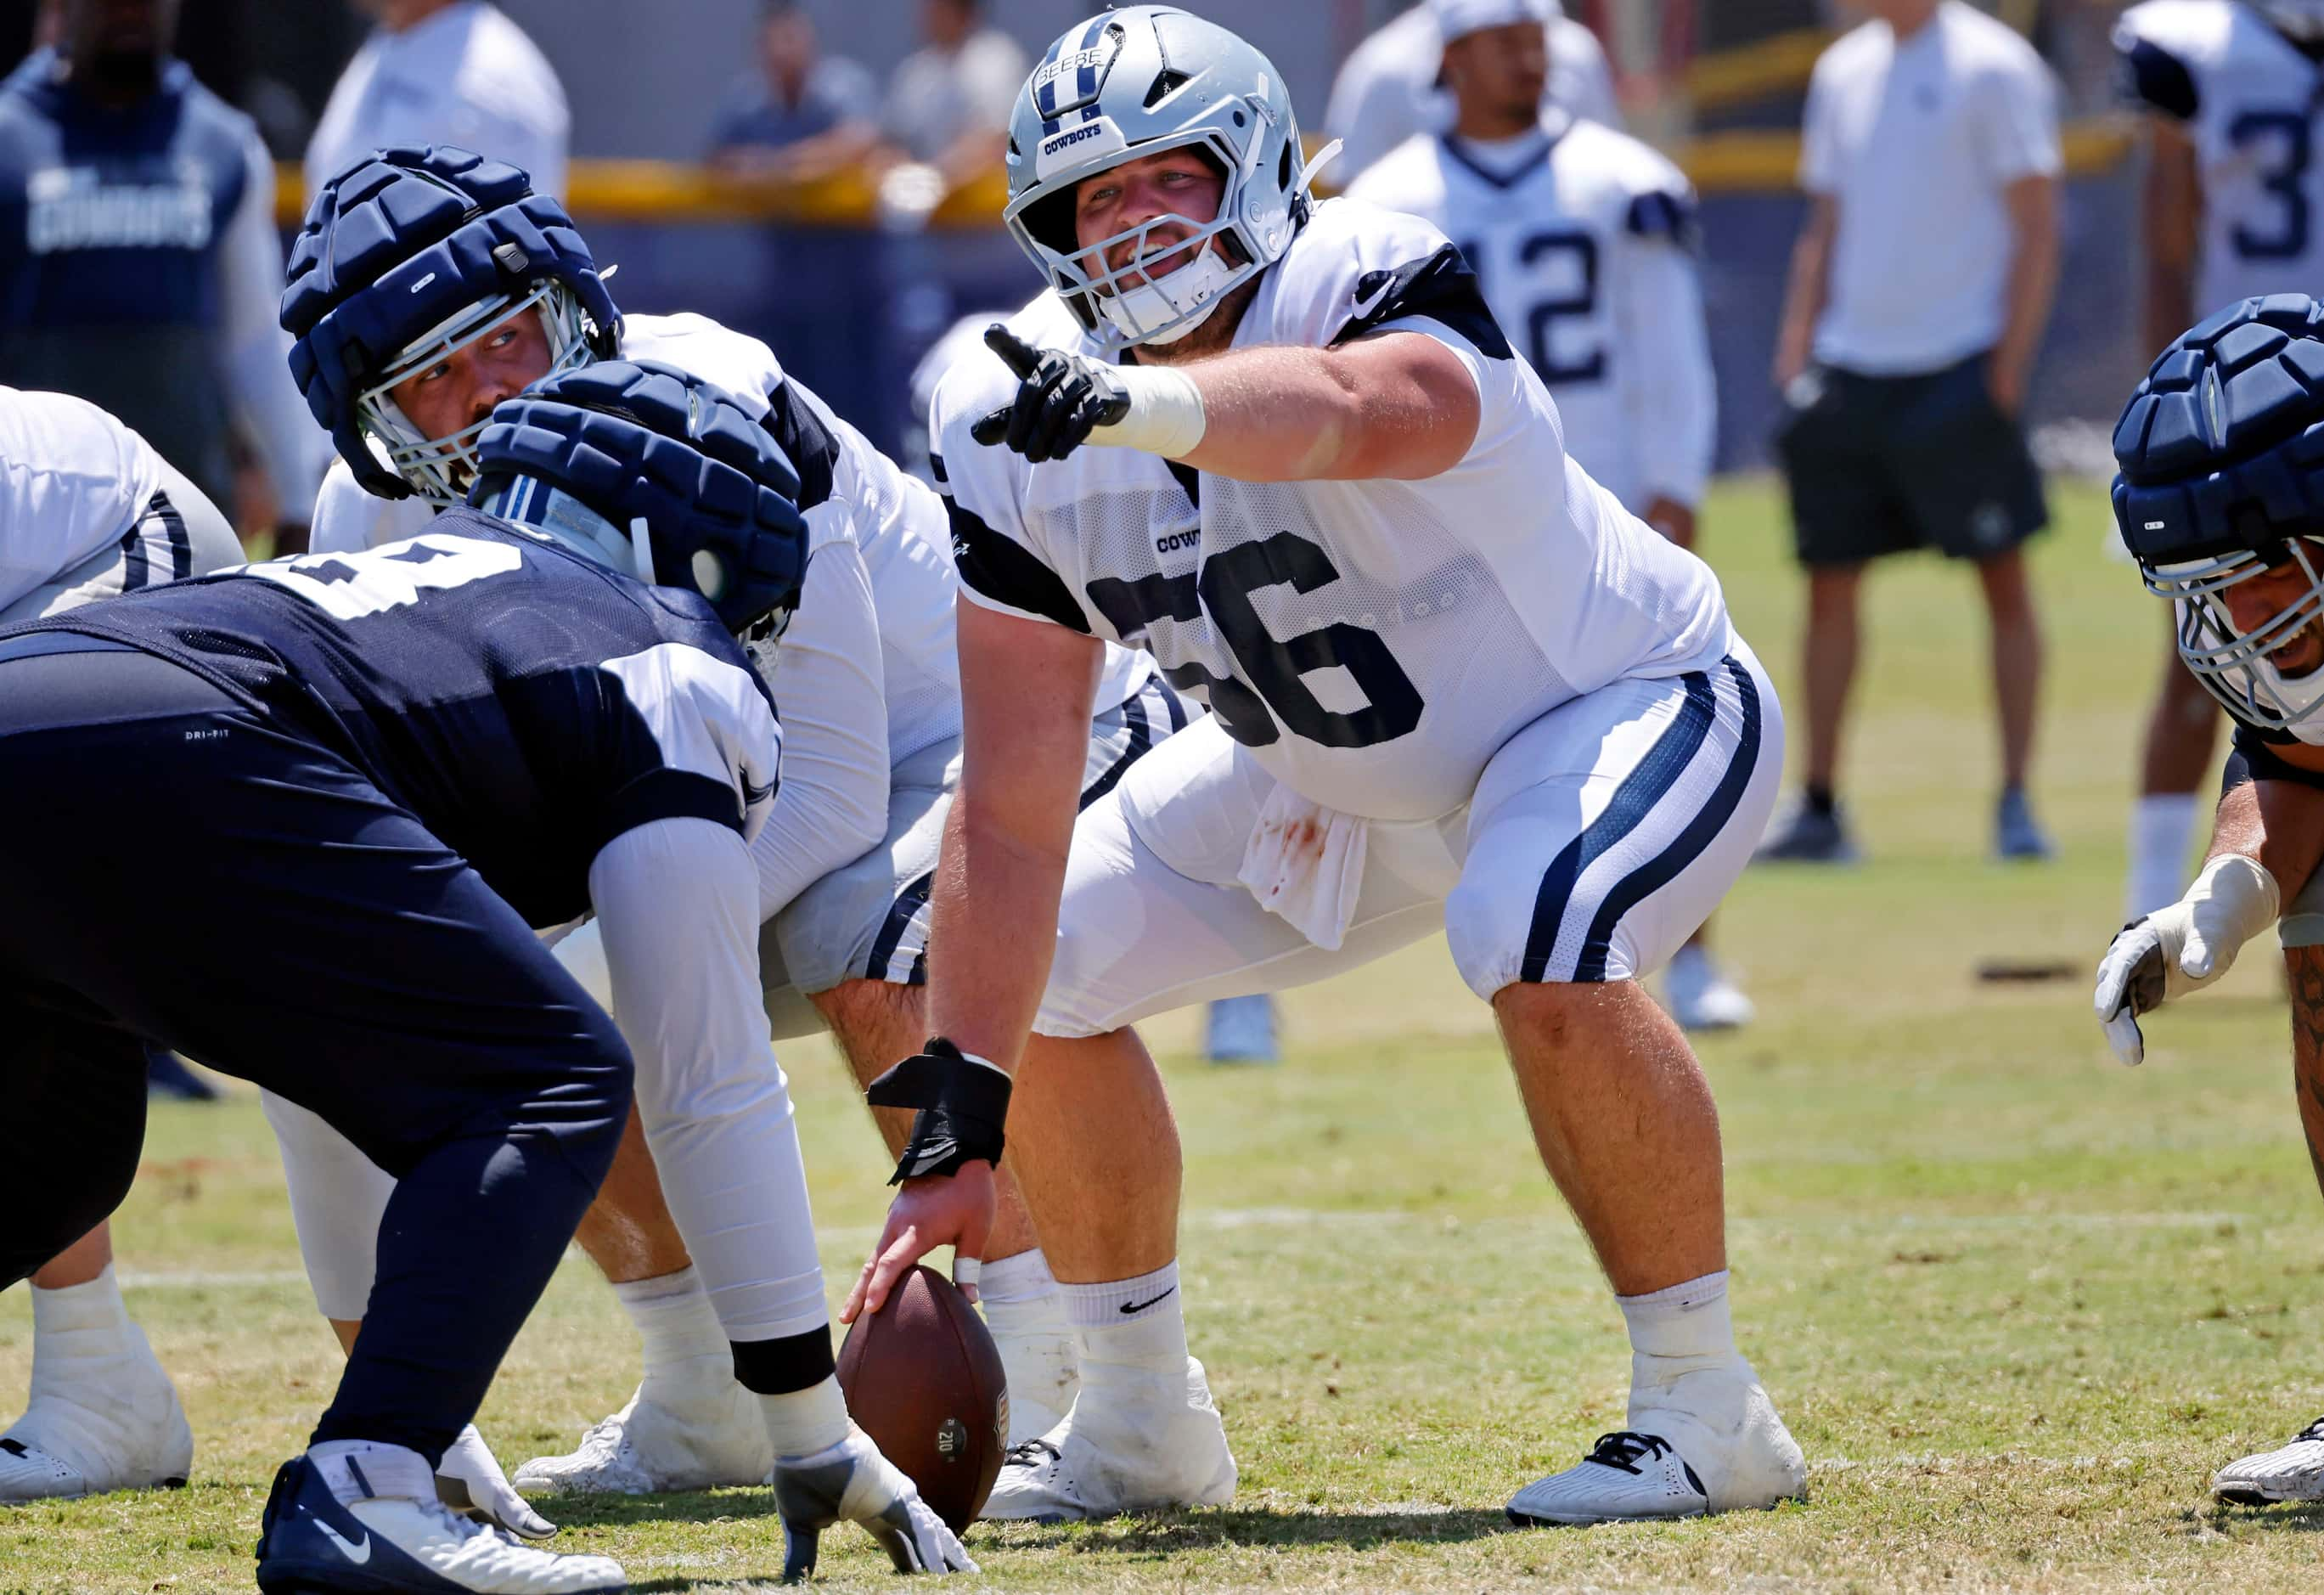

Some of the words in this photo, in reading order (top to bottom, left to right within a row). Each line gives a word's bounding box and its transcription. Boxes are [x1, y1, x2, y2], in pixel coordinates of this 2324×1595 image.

[1038, 48, 1103, 85] BEEBE
[1044, 123, 1102, 155] COWBOYS
[1156, 528, 1201, 554] COW
[185, 729, 228, 740] DRI-FIT
[938, 1431, 954, 1451] 210
